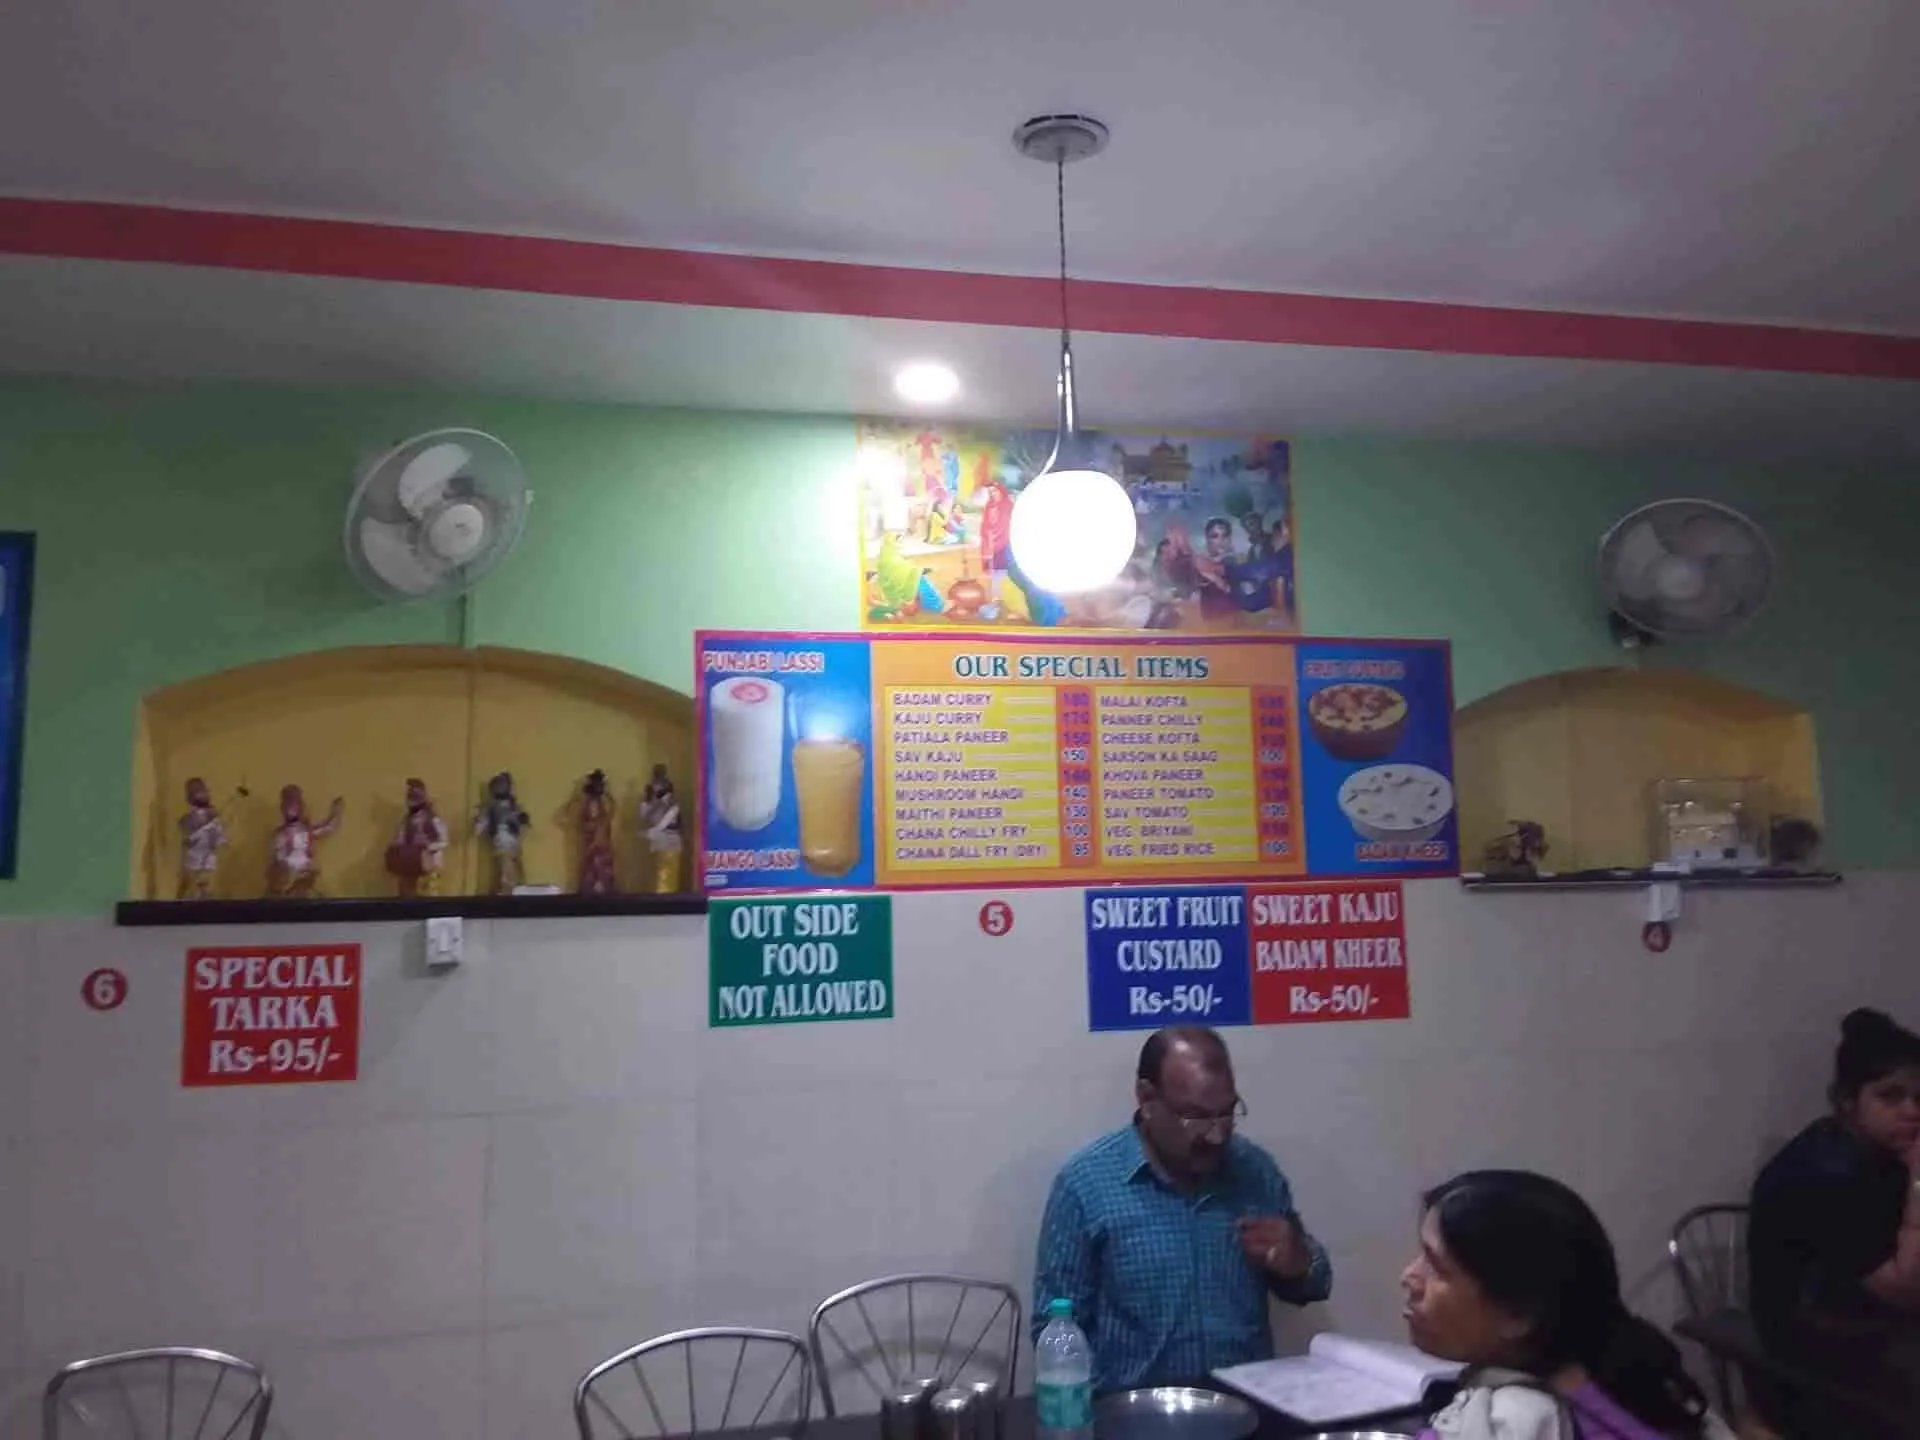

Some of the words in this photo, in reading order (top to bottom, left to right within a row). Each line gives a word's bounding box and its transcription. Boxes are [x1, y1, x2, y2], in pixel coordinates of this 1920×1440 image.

[956, 656, 1009, 677] OUR
[1019, 656, 1127, 678] SPECIAL
[1136, 657, 1209, 678] ITEMS
[894, 693, 943, 705] BADAM
[945, 693, 992, 705] CURRY
[1101, 696, 1142, 708] MALAI
[1146, 696, 1188, 708] KOFTA
[894, 712, 930, 725] KAJU
[936, 712, 982, 725] CURRY
[1158, 714, 1203, 726] CHILLY
[894, 731, 949, 744] PATIALA
[955, 731, 1008, 743] PANEER
[1103, 733, 1153, 745] CHEESE
[1158, 733, 1200, 744] KOFTA
[927, 751, 963, 763] KAJU
[1103, 751, 1155, 763] SARSON
[1161, 751, 1179, 762] KA
[1183, 750, 1218, 762] SAAG
[895, 770, 938, 782] HANDI
[944, 769, 998, 781] PANEER
[1104, 769, 1148, 780] KHOVA
[1153, 769, 1204, 780] PANEER
[895, 788, 977, 801] MUSHROOM
[981, 788, 1024, 800] HANDI
[1104, 788, 1154, 800] PANEER
[1160, 787, 1215, 799] TOMATO
[895, 808, 945, 820] MAITHI
[950, 807, 1003, 819] PANEER
[1136, 806, 1189, 818] TOMATO
[895, 828, 944, 840] CHANA
[949, 827, 995, 839] CHILLY
[1002, 825, 1027, 837] FRY
[895, 847, 946, 860] CHANA
[986, 846, 1009, 857] FRY
[1141, 844, 1179, 856] FRIED
[1184, 843, 1215, 855] RICE
[1092, 897, 1172, 929] SWEET
[1176, 895, 1243, 927] FRUIT
[1252, 894, 1334, 925] SWEET
[1338, 892, 1399, 924] KAJU
[730, 905, 787, 939] OUT
[793, 903, 860, 937] SIDE
[987, 904, 1006, 933] 5
[762, 942, 839, 977] FOOD
[1117, 939, 1222, 971] CUSTARD
[1255, 940, 1328, 972] BADAM
[1333, 937, 1404, 969] KHEER
[194, 956, 353, 990] SPECIAL
[93, 973, 116, 1004] 6
[718, 984, 768, 1019] NOT
[770, 980, 887, 1017] ALLOWED
[1129, 984, 1223, 1015] Rs-50/-
[1289, 984, 1380, 1014] Rs-50/-
[208, 995, 339, 1031] TARKA
[207, 1037, 342, 1076] Rs-95/-
